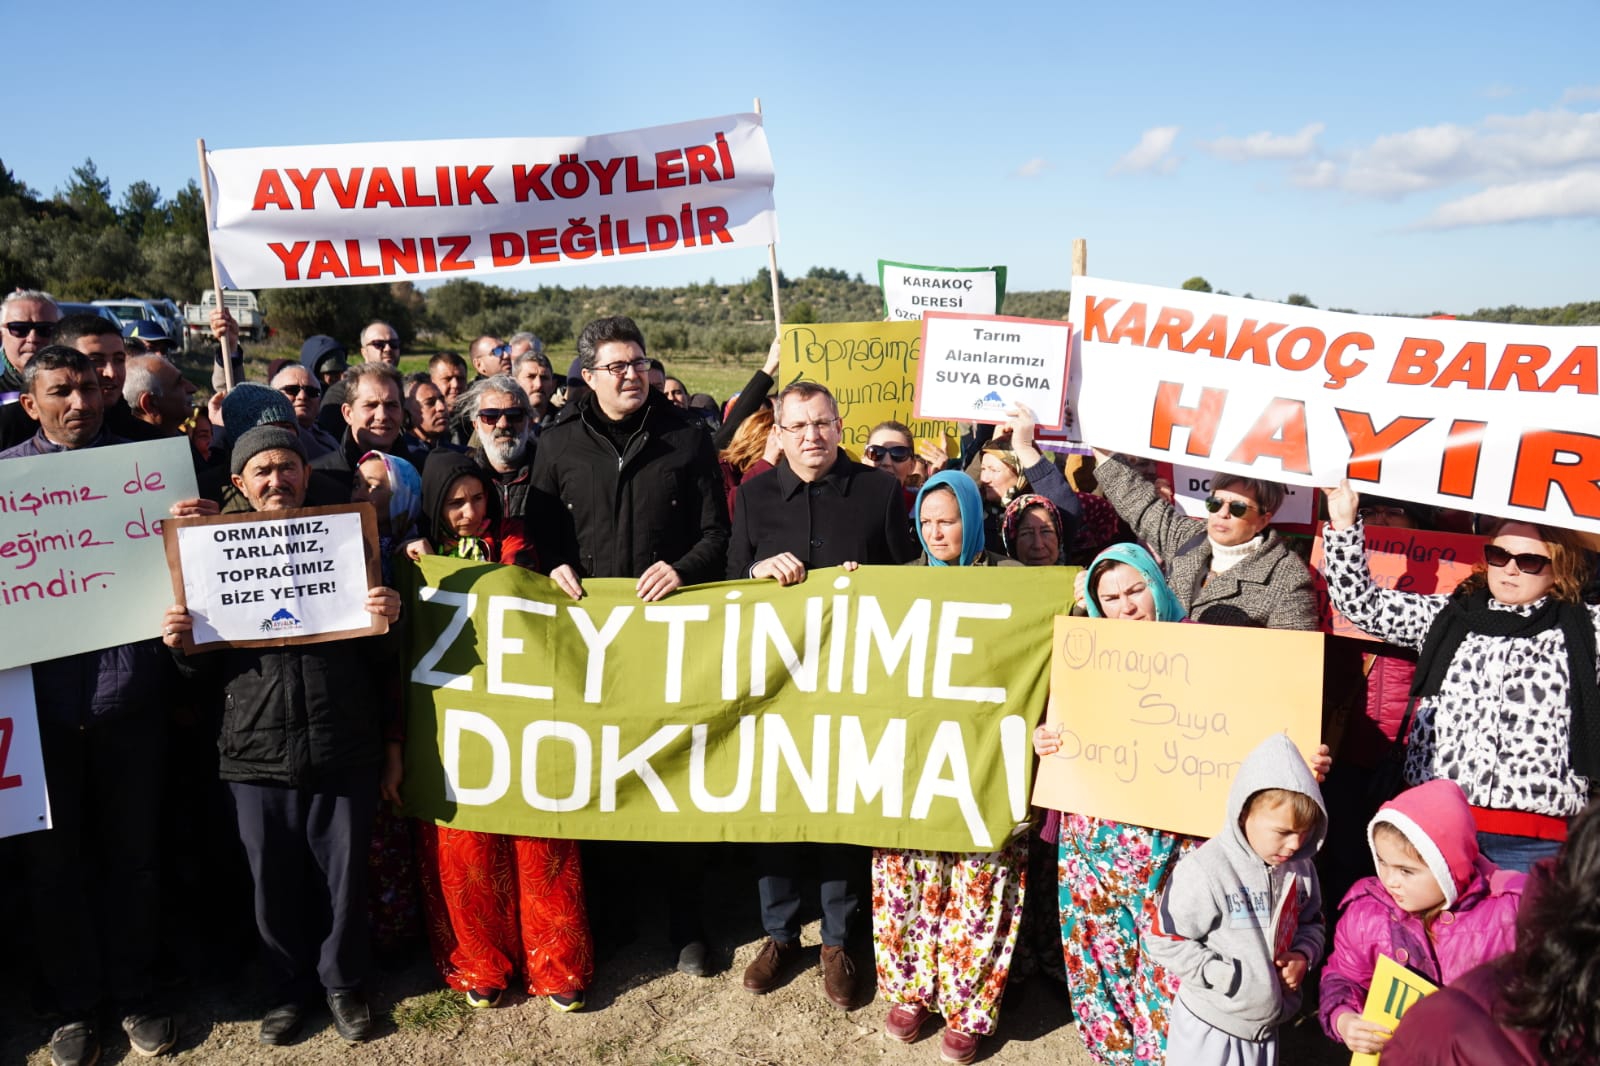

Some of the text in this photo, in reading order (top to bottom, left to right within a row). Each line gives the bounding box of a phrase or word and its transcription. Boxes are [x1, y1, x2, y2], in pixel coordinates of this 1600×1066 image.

[252, 132, 735, 211] AYVALIK KÖYLERİ
[268, 202, 733, 281] YALNIZ DEĞİLDİR
[903, 276, 973, 292] KARAKOÇ
[911, 295, 963, 308] DERESİ
[973, 328, 1021, 343] Tarım
[1083, 295, 1375, 390] KARAKOÇ
[945, 349, 1045, 367] Alanlarımızı
[936, 370, 1050, 390] SUYA BOĞMA
[1149, 380, 1600, 520] HAYIR
[123, 462, 166, 495] de
[213, 521, 330, 543] ORMANIMIZ,
[223, 540, 324, 561] TARLAMIZ,
[217, 560, 335, 584] TOPRAĞIMIZ
[221, 581, 337, 606] BİZE YETER!
[410, 575, 1012, 703] ZEYTİNİME
[1063, 627, 1191, 690] Olmayan
[1130, 694, 1229, 740] Suya
[444, 708, 1027, 847] DOKUNMA!
